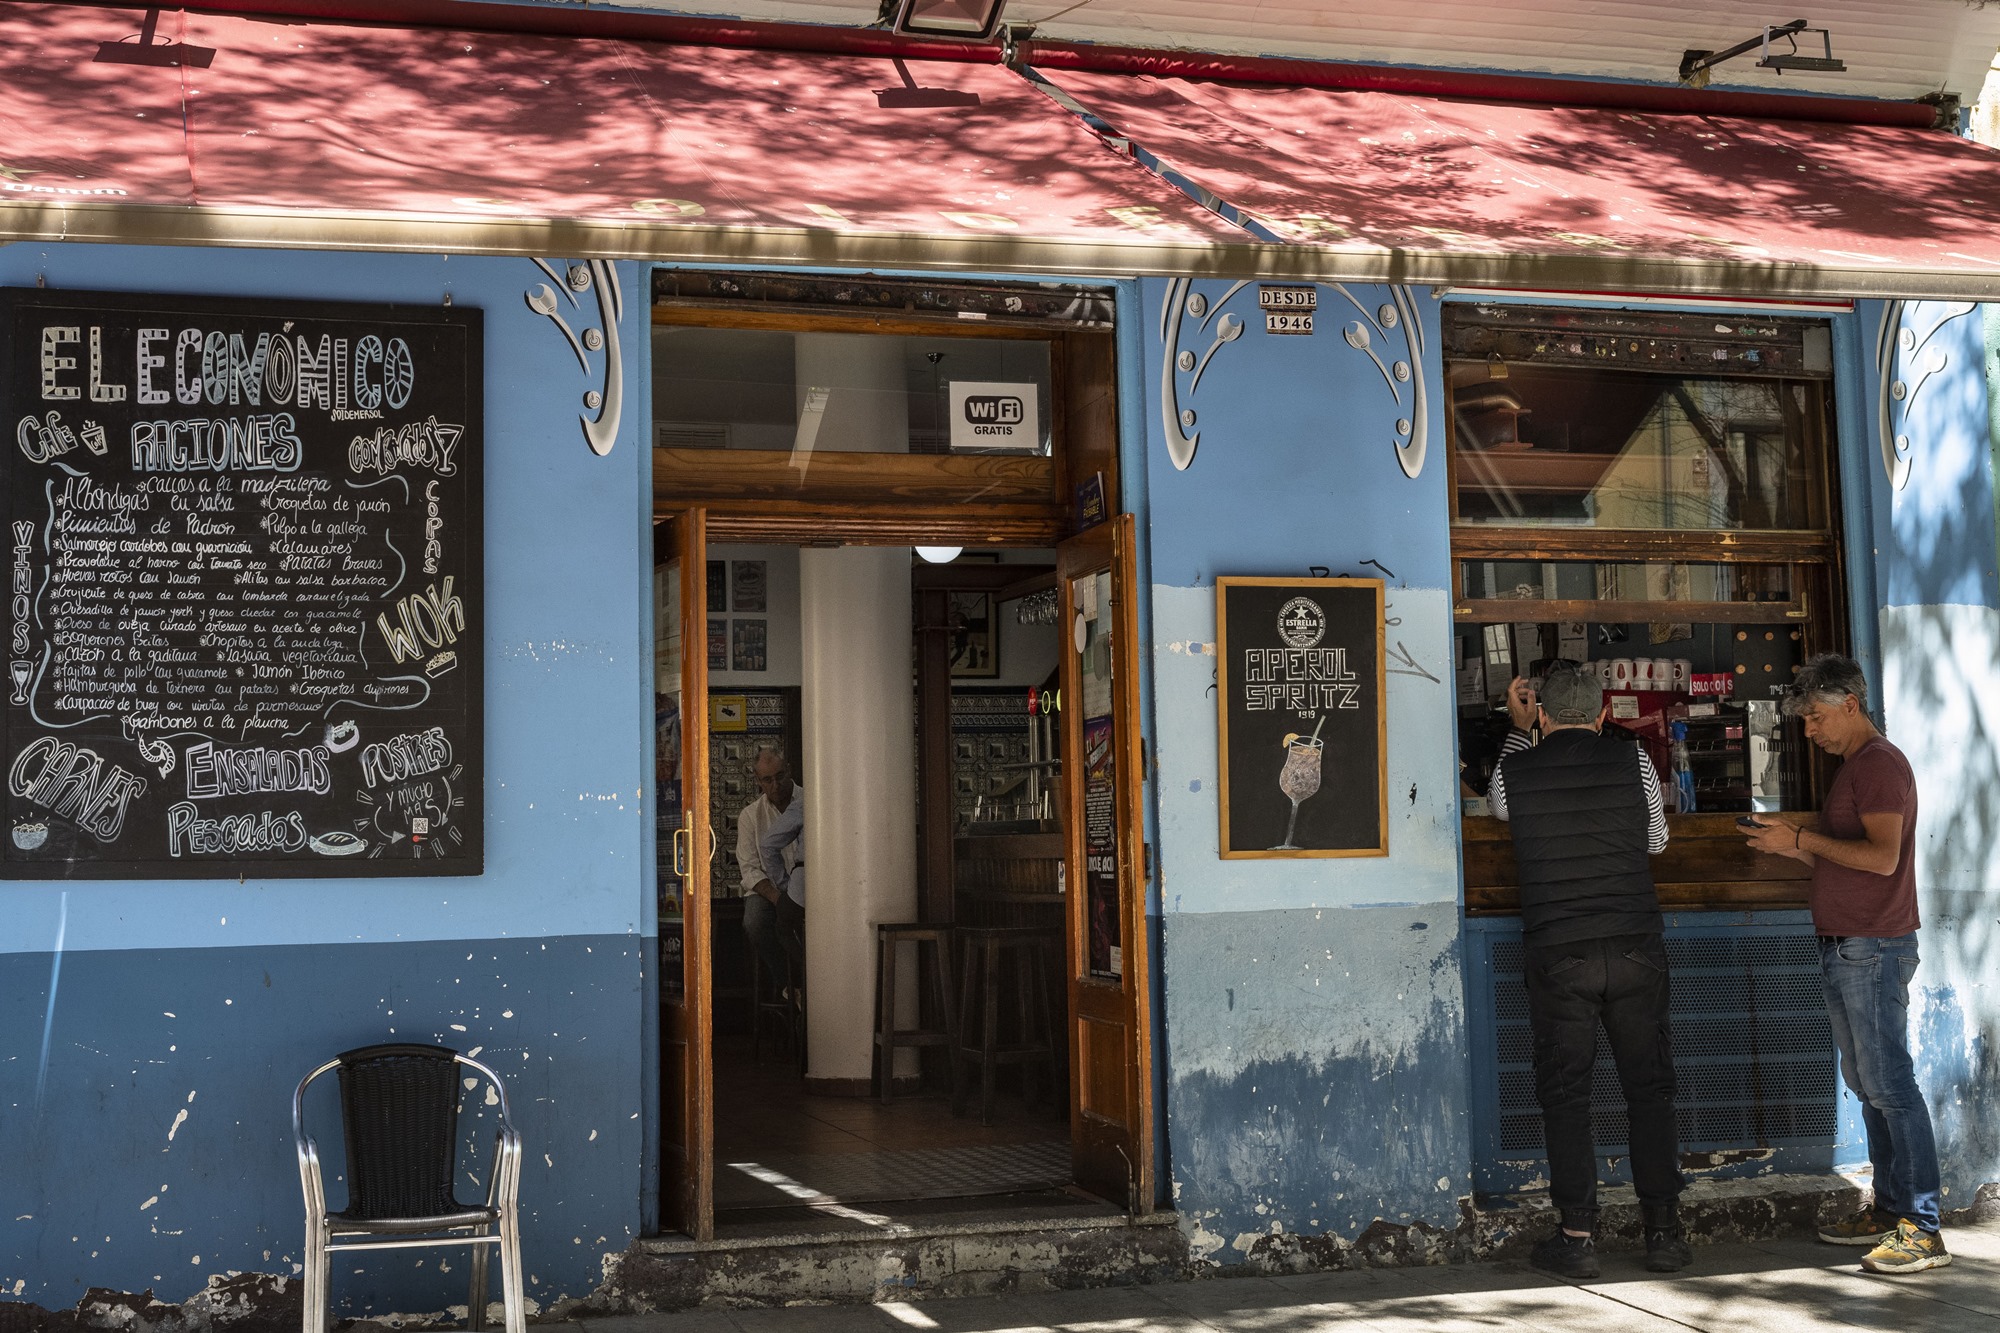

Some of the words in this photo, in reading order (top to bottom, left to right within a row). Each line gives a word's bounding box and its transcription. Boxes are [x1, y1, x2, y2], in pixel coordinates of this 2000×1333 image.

[2, 182, 129, 196] Damm
[1261, 290, 1316, 305] DESDE
[1269, 316, 1313, 331] 1946
[42, 325, 127, 401] EL
[968, 399, 1019, 422] WiFi
[974, 425, 1013, 436] GRATIS
[131, 413, 303, 472] RACIONES
[199, 481, 211, 493] a
[195, 492, 234, 512] salsa
[267, 489, 327, 523] Croquetas
[333, 495, 349, 512] de
[150, 514, 170, 535] de
[186, 513, 235, 535] Padrón
[267, 512, 297, 543] Pulpo
[300, 521, 308, 534] a
[311, 517, 322, 534] la
[424, 480, 445, 575] COPAS
[275, 539, 352, 554] Calamares
[60, 569, 96, 583] Huevos
[100, 571, 133, 583] rotos
[247, 560, 267, 570] seco
[12, 520, 36, 654] VINOS
[296, 574, 325, 586] salsa
[331, 573, 388, 586] barbacoa
[113, 587, 125, 599] de
[128, 591, 154, 605] queso
[159, 587, 172, 599] de
[176, 588, 206, 600] cabra
[242, 590, 289, 601] lombarda
[296, 590, 370, 610] caramelizada
[60, 601, 114, 616] Quesadilla
[120, 605, 130, 616] de
[199, 607, 206, 622] y
[209, 607, 235, 621] queso
[305, 606, 363, 625] guacamole
[377, 574, 466, 665] WOK
[1285, 619, 1317, 627] ESTRELLA
[60, 617, 93, 631] Queso
[98, 618, 111, 630] de
[117, 619, 150, 637] oveja
[204, 620, 247, 633] artesano
[271, 621, 305, 634] aceite
[310, 622, 322, 634] de
[328, 621, 358, 634] oliva
[257, 638, 268, 649] a
[273, 635, 287, 648] la
[111, 649, 124, 662] a
[128, 647, 143, 662] la
[148, 648, 198, 672] gaditana
[1245, 648, 1359, 682] APEROL
[104, 664, 117, 678] de
[124, 664, 147, 685] pollo
[176, 667, 228, 684] guacamole
[251, 664, 293, 679] Jamón
[301, 664, 346, 680] Ibérico
[63, 678, 138, 699] Hamburguesa
[146, 680, 160, 694] de
[166, 681, 206, 694] ternera
[239, 685, 279, 702] patatas
[298, 681, 355, 703] Croquetas
[1246, 683, 1361, 711] SPRITZ
[117, 697, 131, 711] de
[135, 698, 160, 718] buey
[232, 700, 249, 712] de
[203, 716, 214, 728] a
[221, 714, 236, 729] la
[361, 726, 453, 788] POSTRES
[186, 741, 331, 799] ENSALADAS
[8, 736, 148, 843] CARNES
[386, 790, 395, 812] Y
[398, 781, 435, 806] MUCHO
